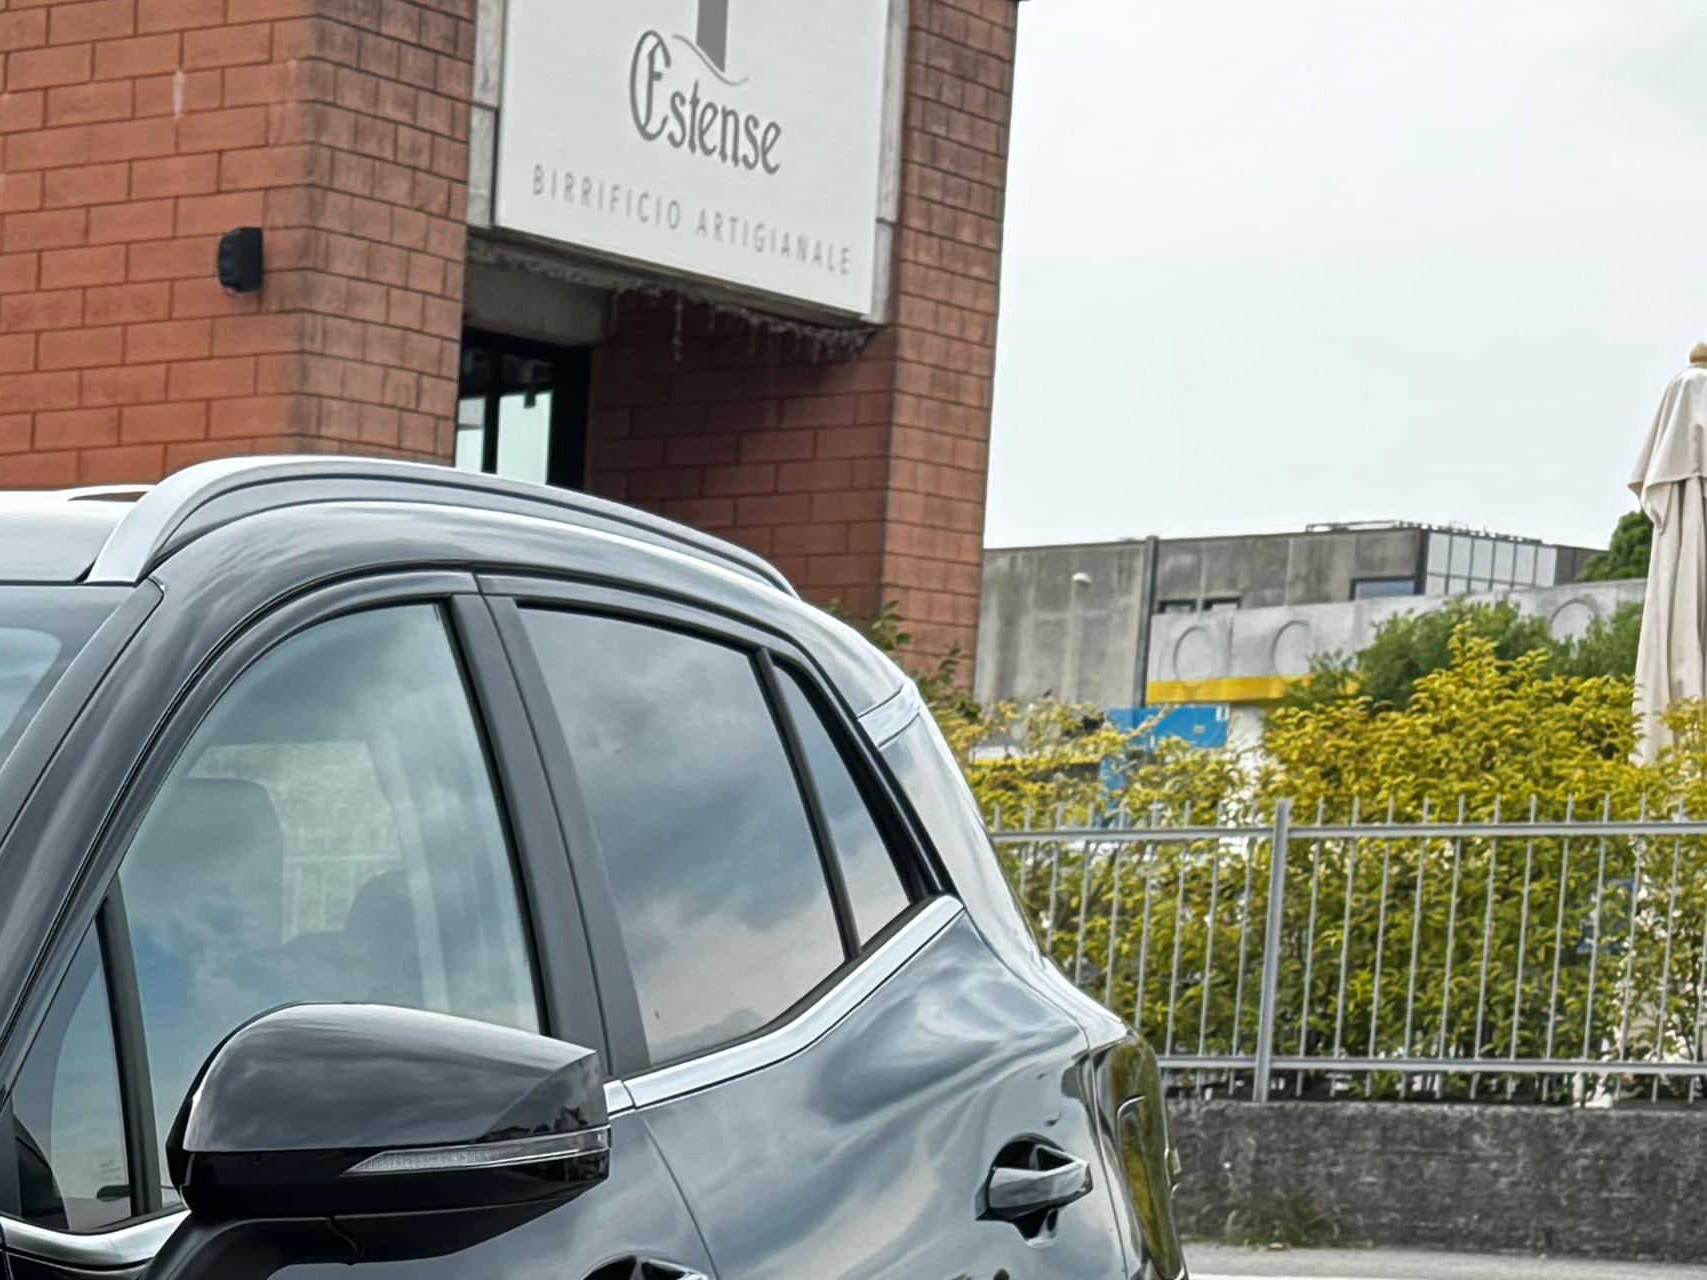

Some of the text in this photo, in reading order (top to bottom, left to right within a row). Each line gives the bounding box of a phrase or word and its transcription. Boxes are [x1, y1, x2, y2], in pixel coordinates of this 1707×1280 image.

[629, 29, 783, 176] Estense
[532, 164, 851, 276] BIRRIFICIO ARTIGIANALE
